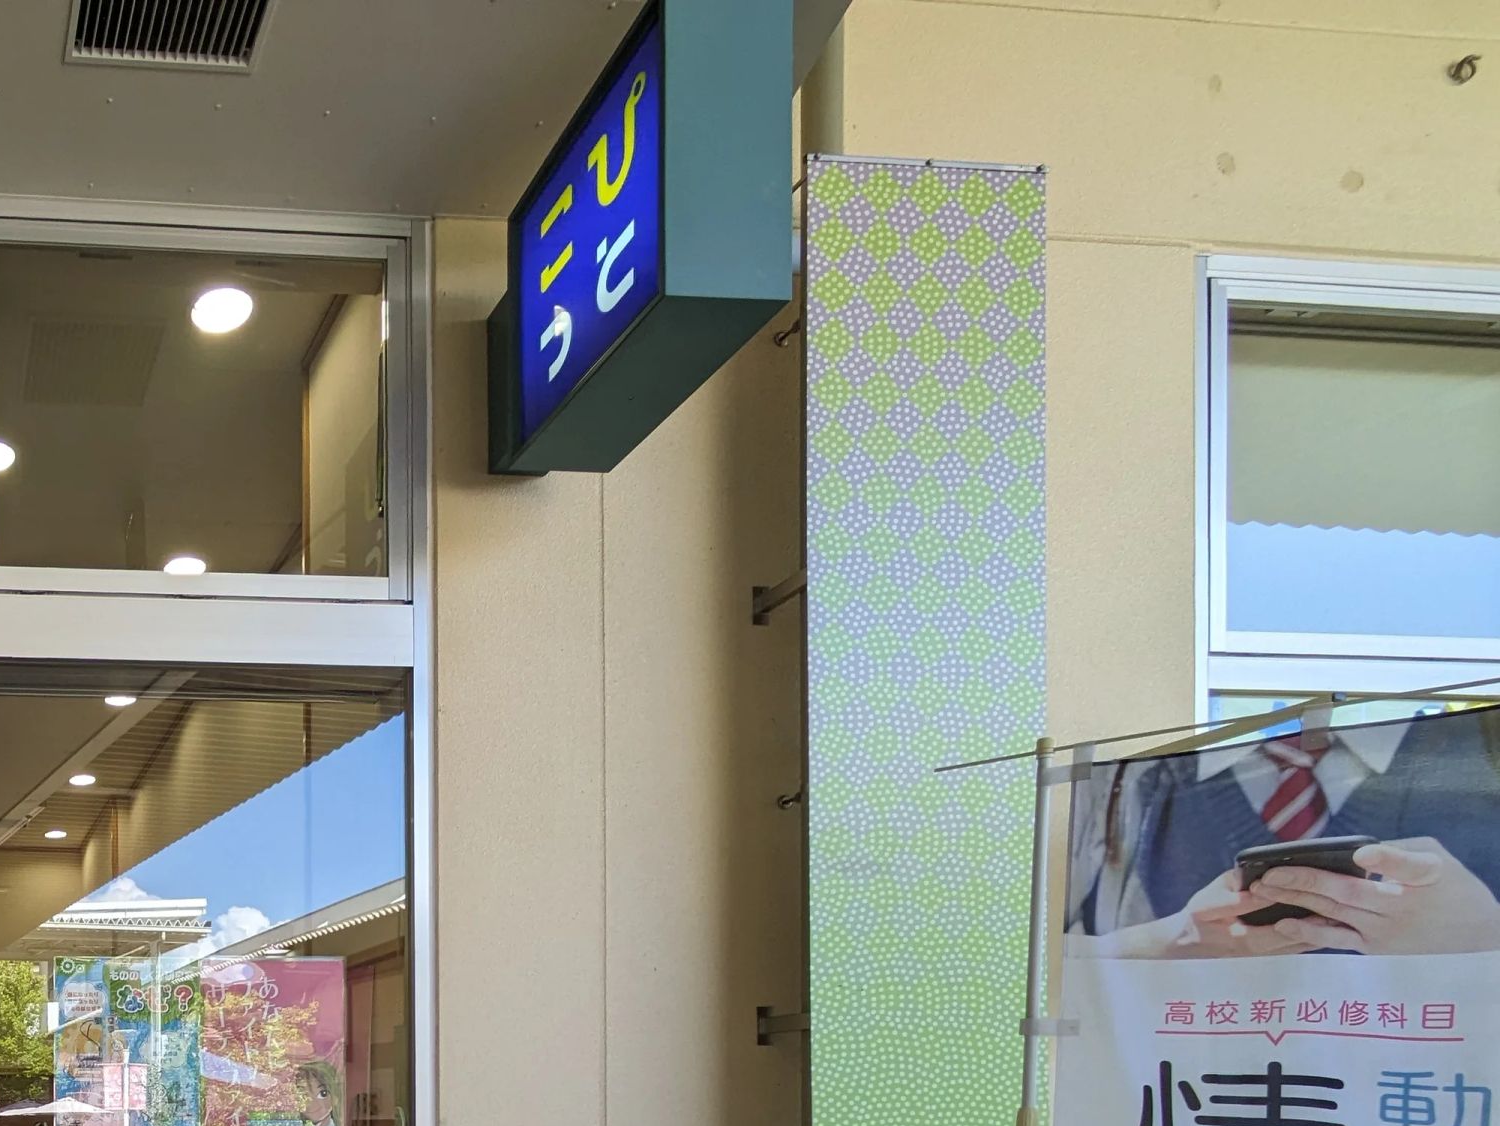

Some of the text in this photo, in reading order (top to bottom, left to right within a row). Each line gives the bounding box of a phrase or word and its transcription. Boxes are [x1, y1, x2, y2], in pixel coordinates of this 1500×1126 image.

[1164, 998, 1457, 1031] 高校新必修科目
